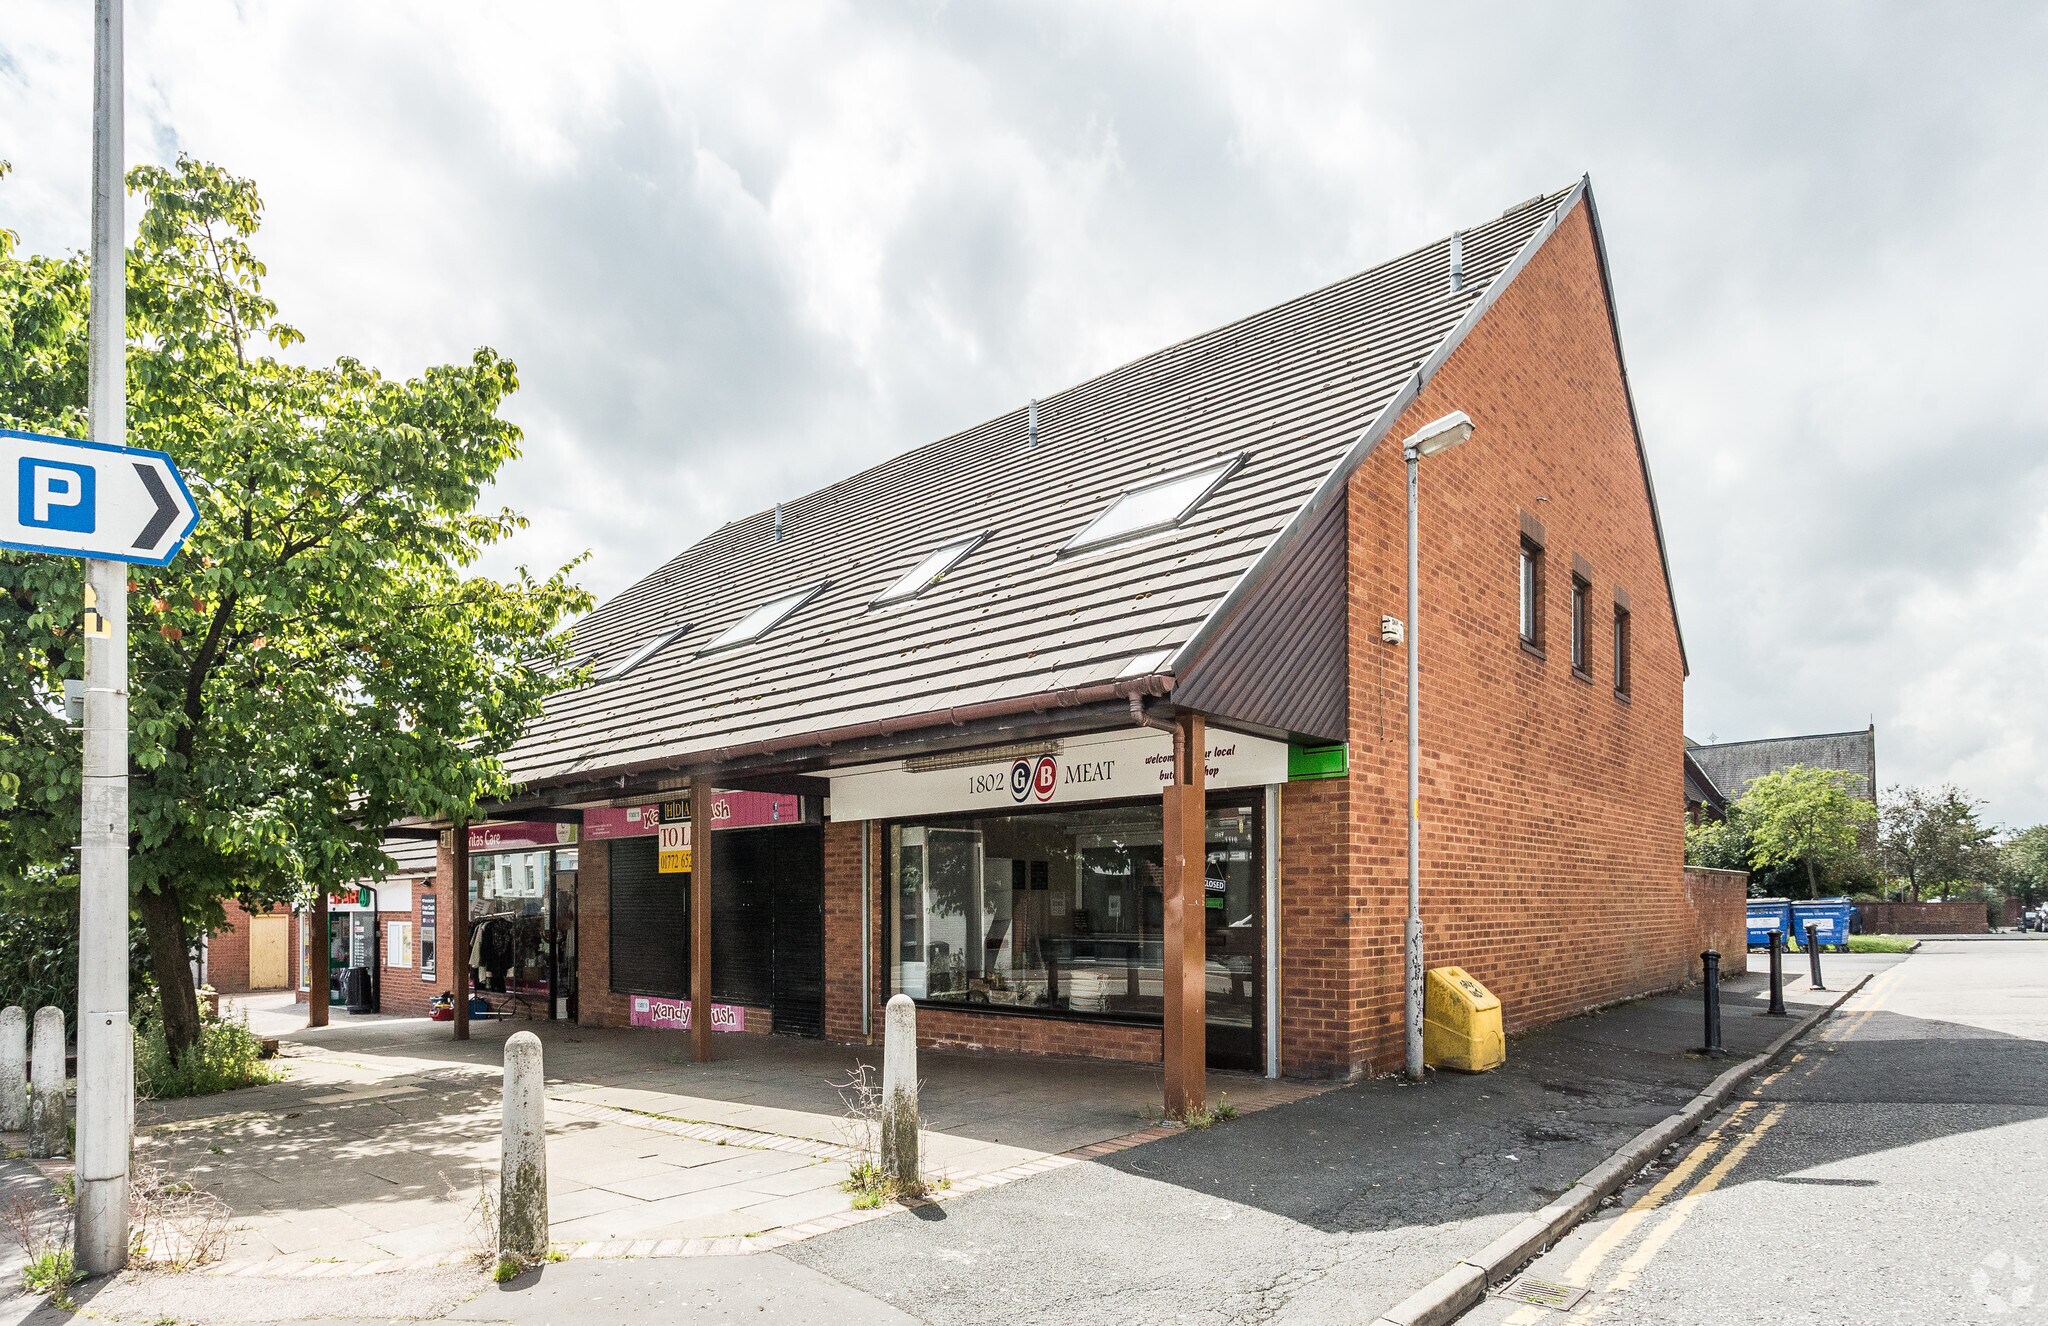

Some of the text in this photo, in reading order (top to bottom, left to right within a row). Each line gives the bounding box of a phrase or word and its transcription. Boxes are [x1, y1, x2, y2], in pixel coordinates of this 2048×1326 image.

[33, 465, 82, 522] P
[1145, 753, 1174, 765] welcom
[1213, 744, 1236, 757] local
[969, 772, 1004, 794] 1802
[1064, 760, 1115, 784] MEAT
[1205, 765, 1219, 778] hop
[469, 829, 501, 847] ritas Care
[661, 826, 691, 847] TO L
[660, 854, 679, 869] 01772
[651, 1000, 736, 1028] Kandy ush
